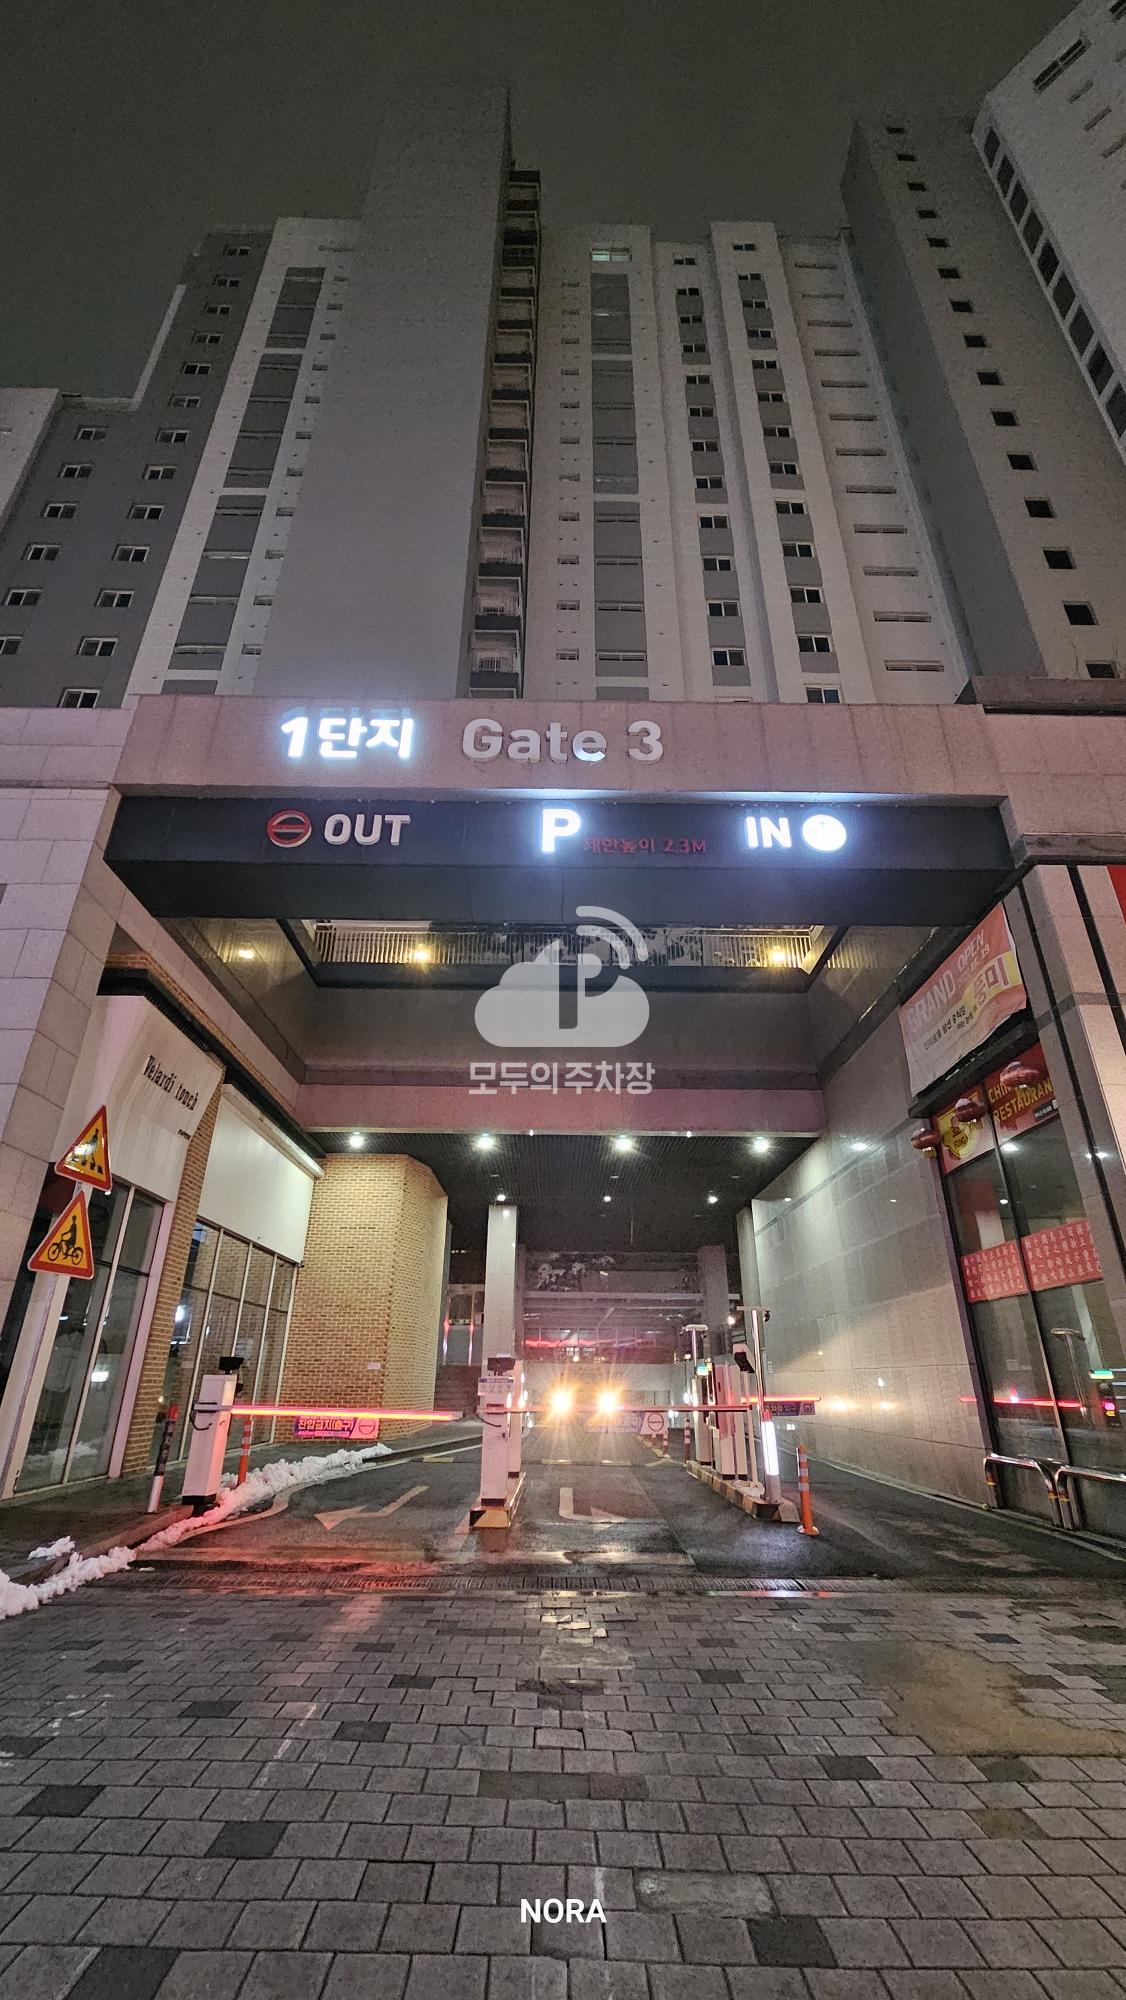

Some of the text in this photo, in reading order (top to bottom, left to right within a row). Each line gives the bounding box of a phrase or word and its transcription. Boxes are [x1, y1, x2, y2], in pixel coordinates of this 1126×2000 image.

[280, 716, 664, 764] 1단지 Gate 3
[324, 813, 411, 846] OUT
[541, 808, 581, 853] P
[584, 838, 707, 854] 제한높이 2.3M
[746, 815, 793, 849] IN
[906, 969, 956, 1026] GRAND
[957, 929, 984, 971] OPEN
[993, 1078, 1054, 1122] RESTAURAN
